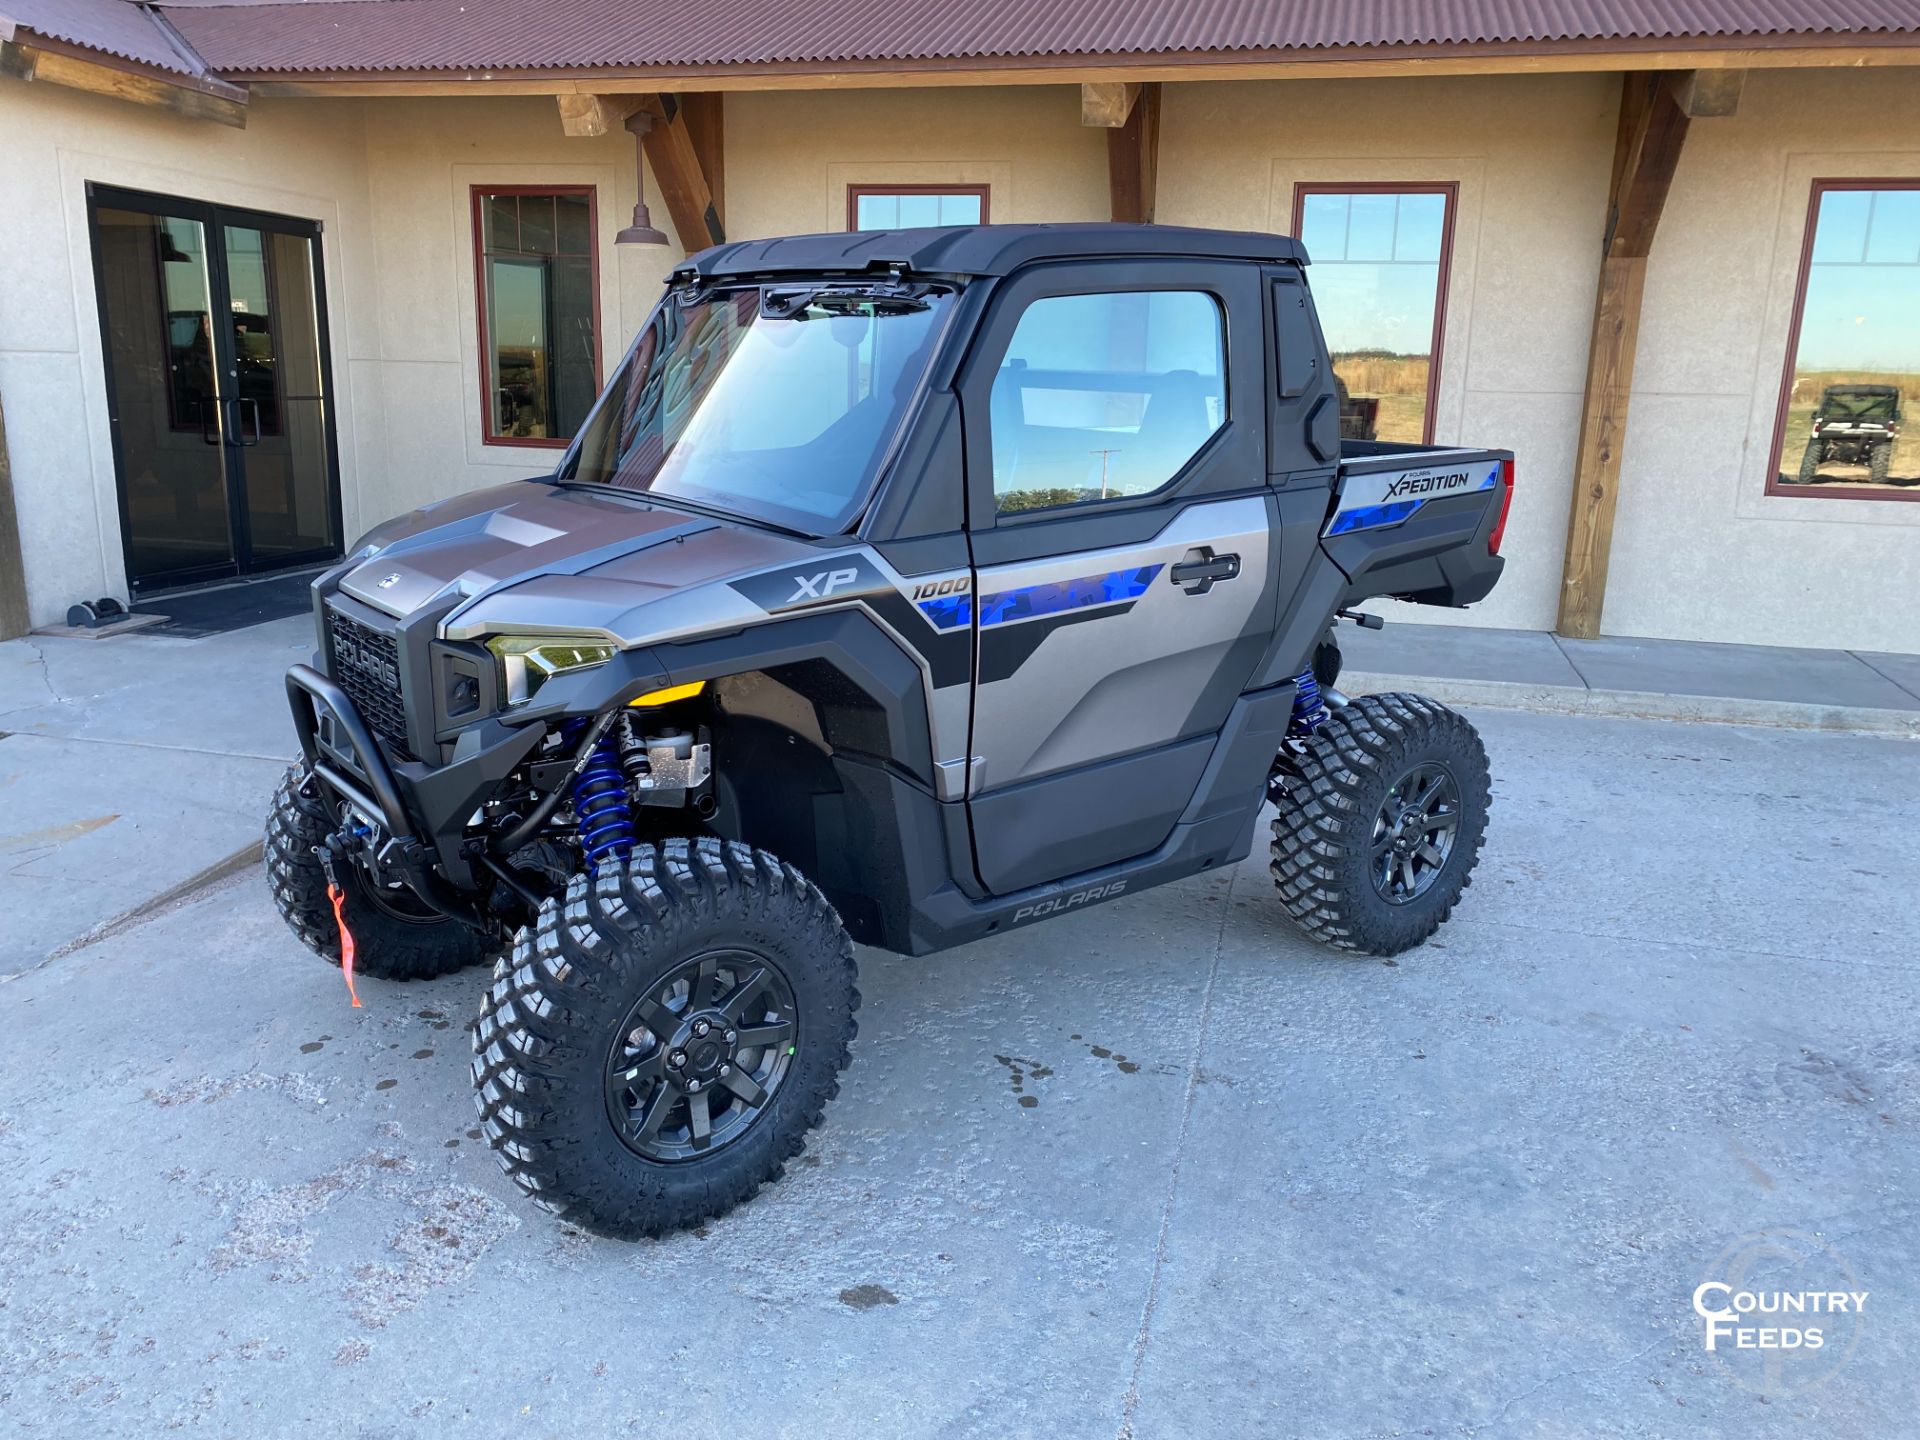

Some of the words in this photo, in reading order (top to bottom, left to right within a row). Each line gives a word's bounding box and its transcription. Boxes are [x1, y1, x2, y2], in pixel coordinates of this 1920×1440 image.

[1381, 472, 1469, 502] XPEDITION
[786, 567, 858, 602] XP
[912, 576, 970, 600] 1000
[332, 633, 398, 688] POLARIS
[1012, 880, 1128, 923] POLARIS
